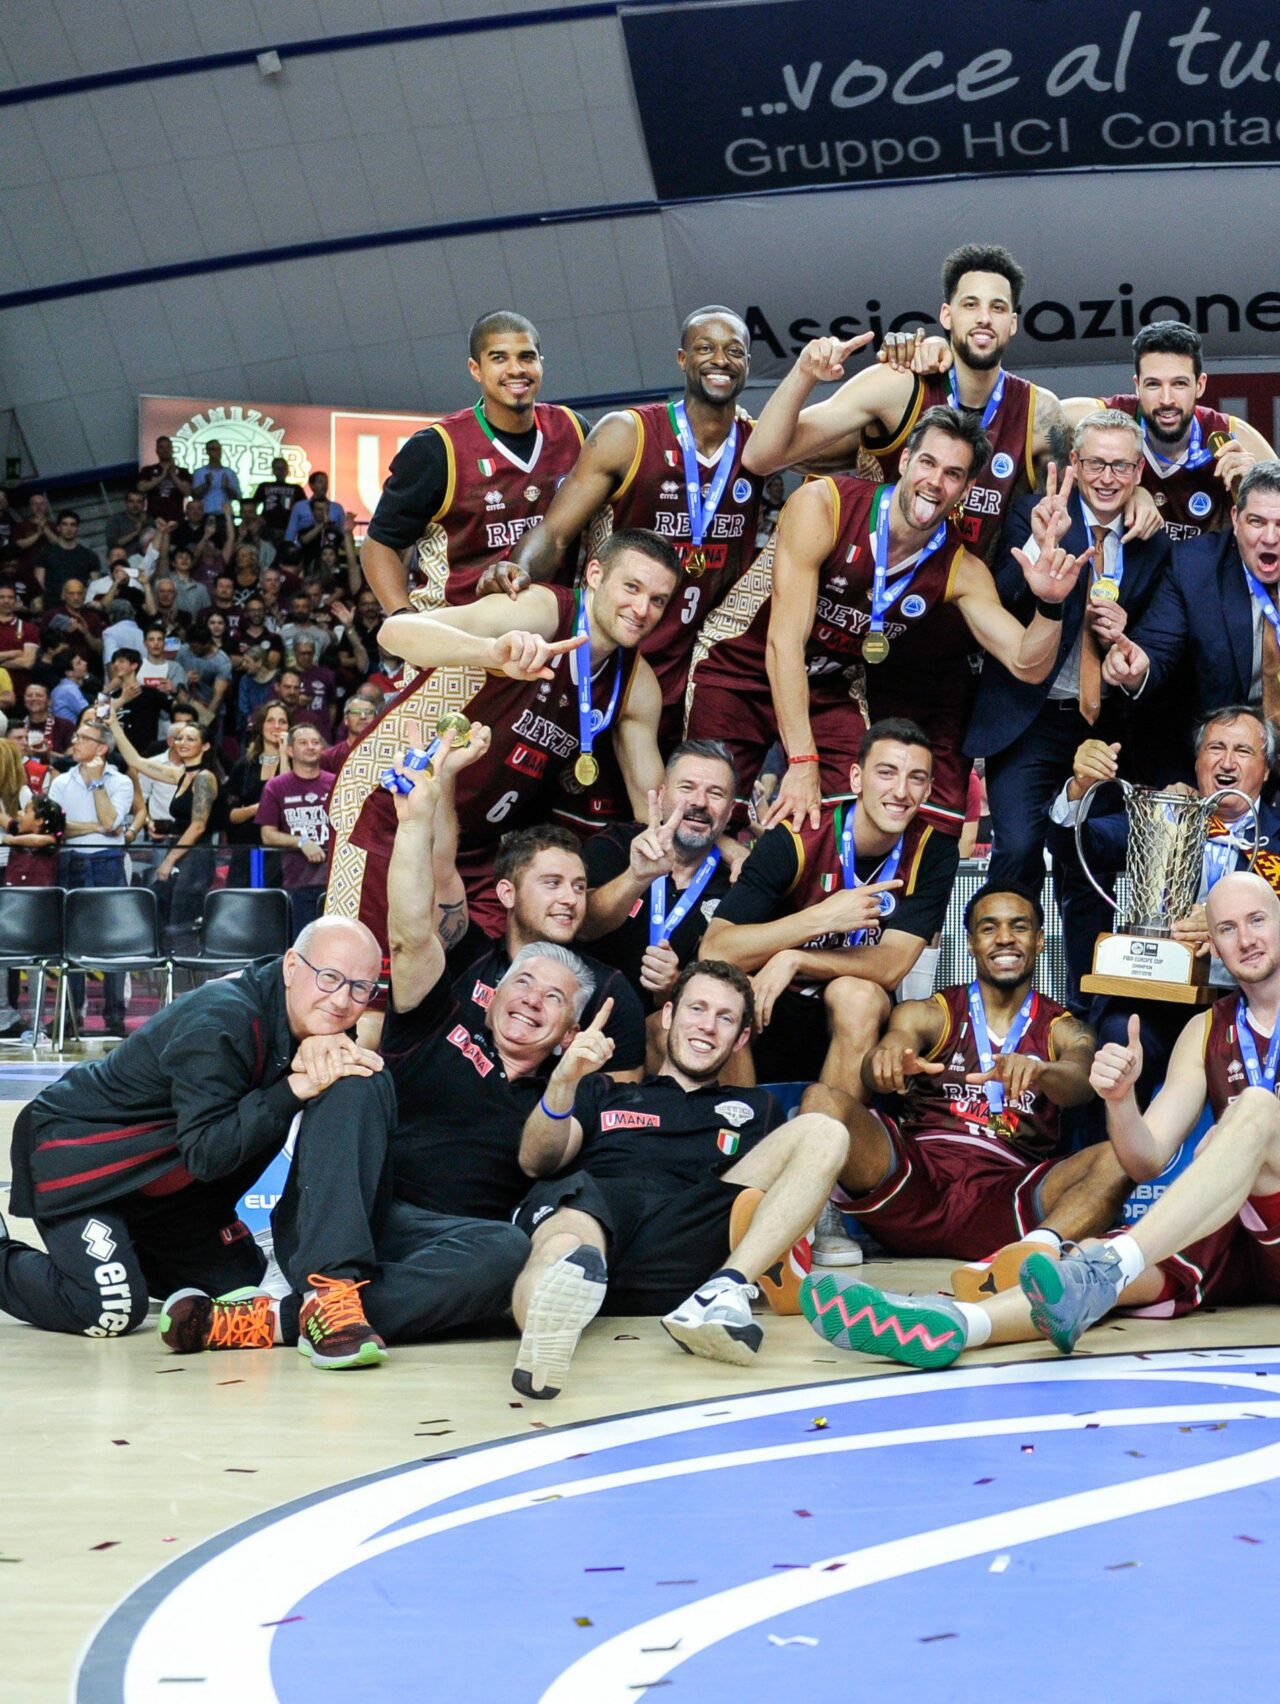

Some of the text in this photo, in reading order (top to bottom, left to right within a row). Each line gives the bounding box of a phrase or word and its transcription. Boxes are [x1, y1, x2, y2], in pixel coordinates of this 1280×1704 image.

[1045, 10, 1143, 98] al
[723, 132, 942, 178] Gruppo
[964, 117, 1070, 160] HCI
[680, 586, 701, 625] 3
[486, 790, 519, 823] 6
[605, 1113, 655, 1128] UMANA
